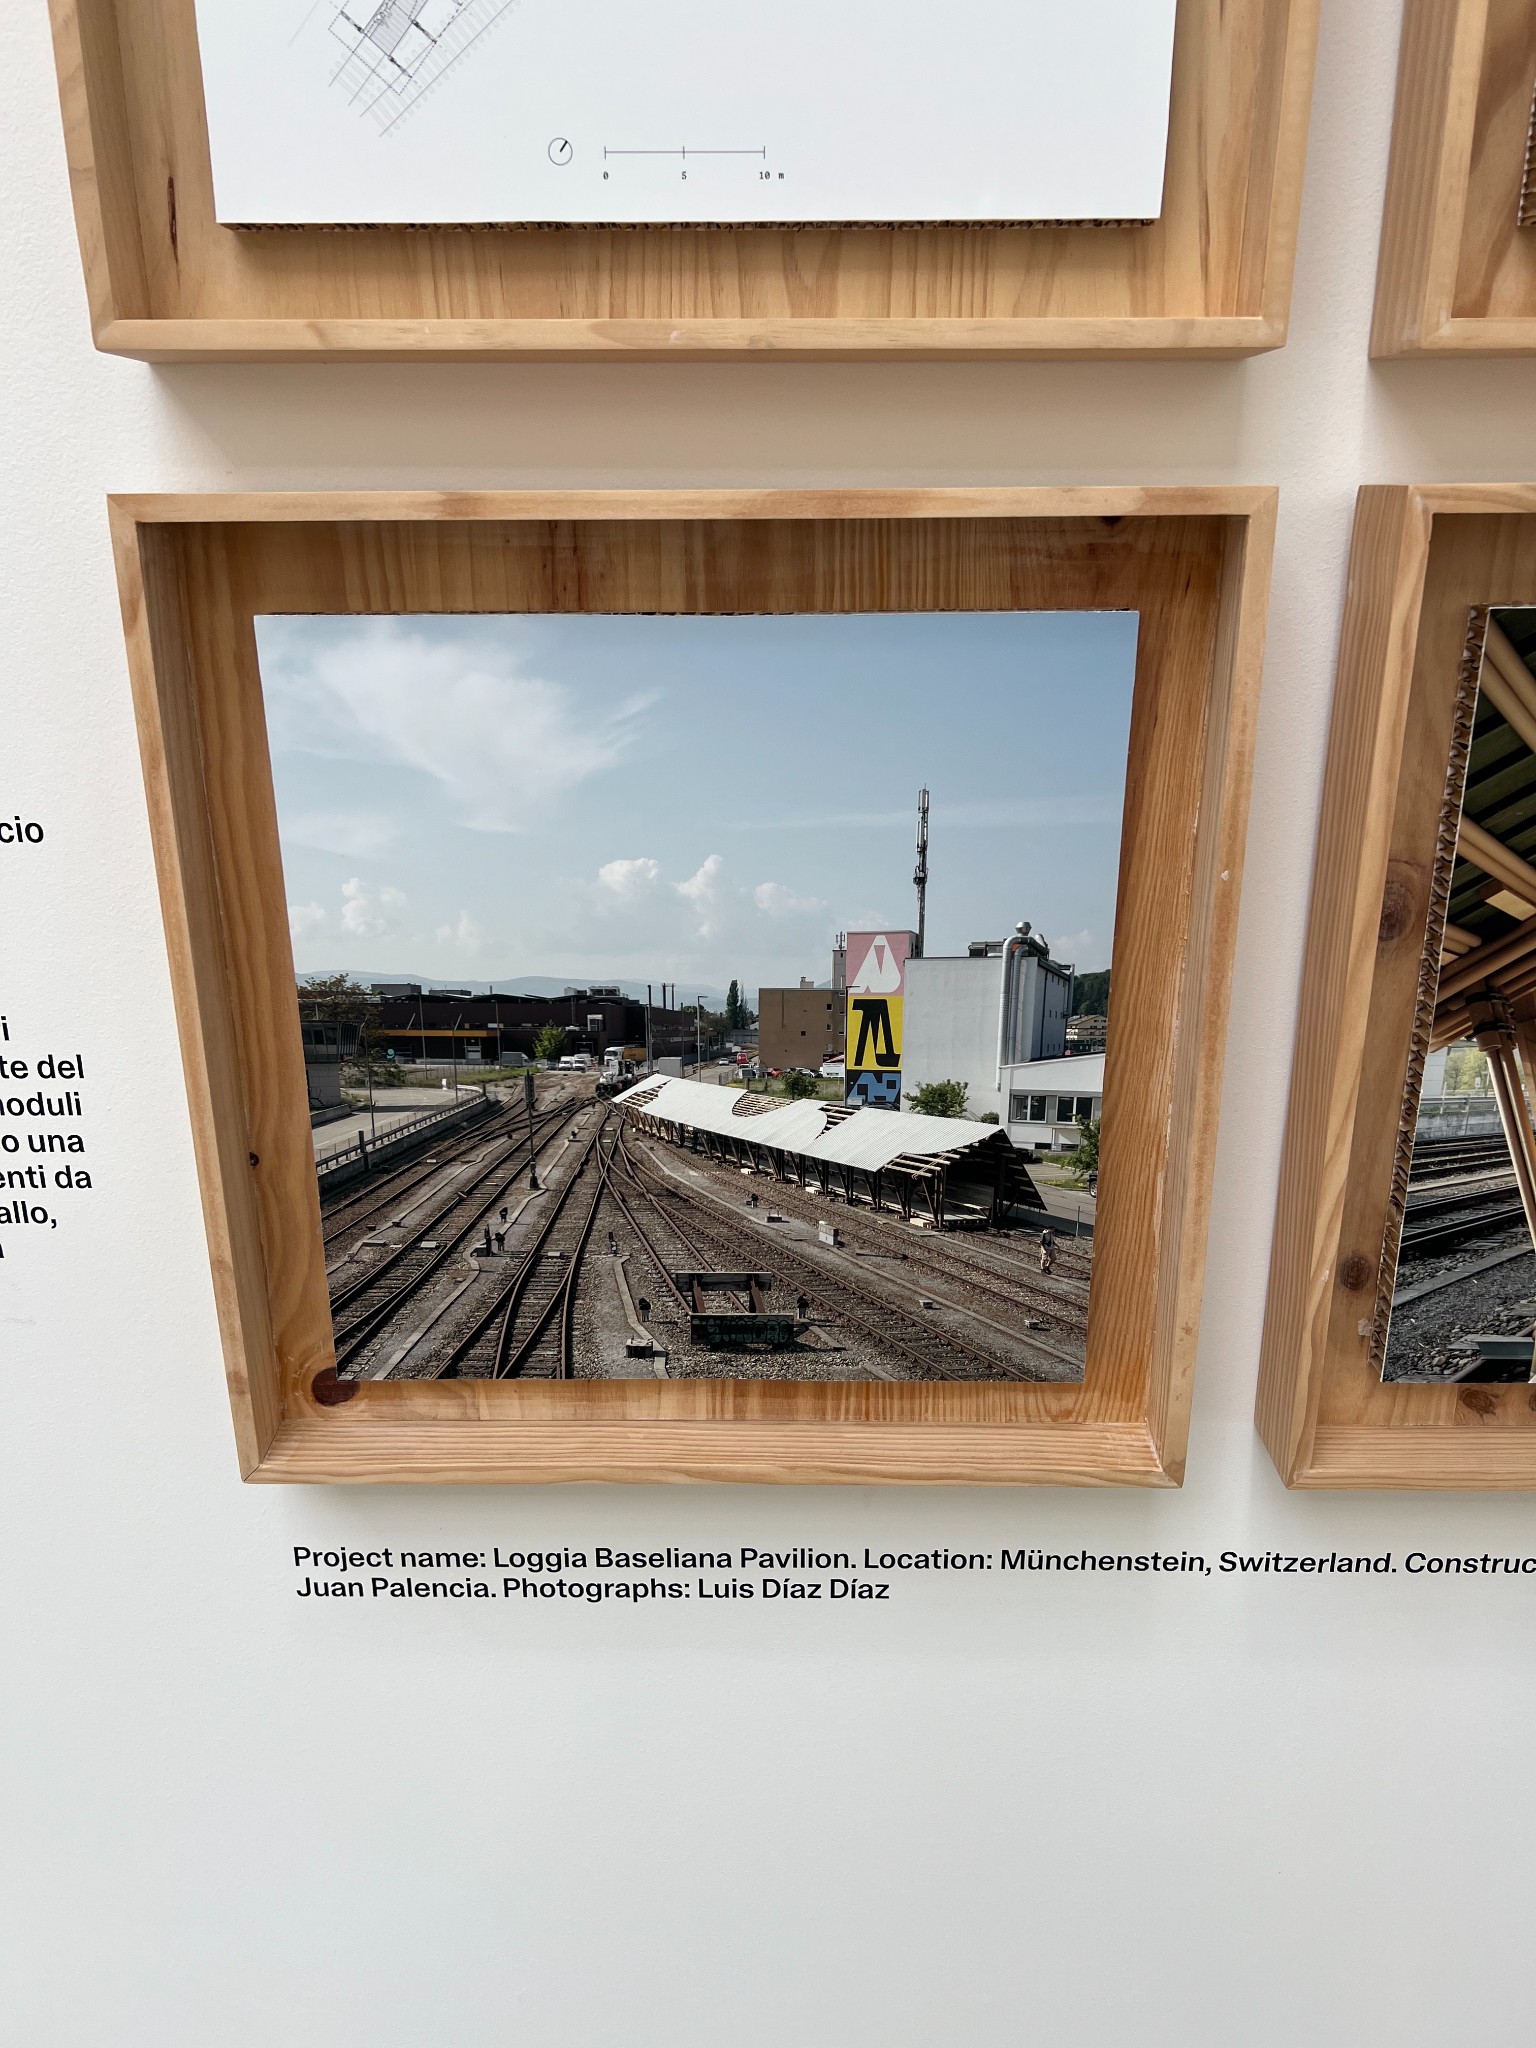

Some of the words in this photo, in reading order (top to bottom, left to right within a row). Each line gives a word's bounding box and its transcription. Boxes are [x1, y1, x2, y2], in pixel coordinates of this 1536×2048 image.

[681, 170, 688, 181] 5
[758, 170, 771, 181] 10
[778, 172, 785, 180] m
[0, 815, 44, 844] cio
[36, 1054, 85, 1080] del
[27, 1134, 86, 1153] una
[54, 1164, 93, 1189] da
[293, 1546, 394, 1573] Project
[400, 1552, 486, 1568] name:
[493, 1547, 588, 1573] Loggia
[595, 1547, 733, 1569] Baseliana
[740, 1547, 857, 1569] Pavilion.
[864, 1548, 993, 1570] Location:
[1000, 1549, 1212, 1577] Münchenstein,
[1218, 1551, 1397, 1574] Switzerland.
[1404, 1552, 1536, 1574] Construc
[296, 1576, 364, 1598] Juan
[371, 1577, 497, 1598] Palencia.
[503, 1577, 690, 1603] Photographs:
[698, 1577, 755, 1599] Luis
[762, 1577, 822, 1599] Díaz
[830, 1578, 890, 1600] Díaz
